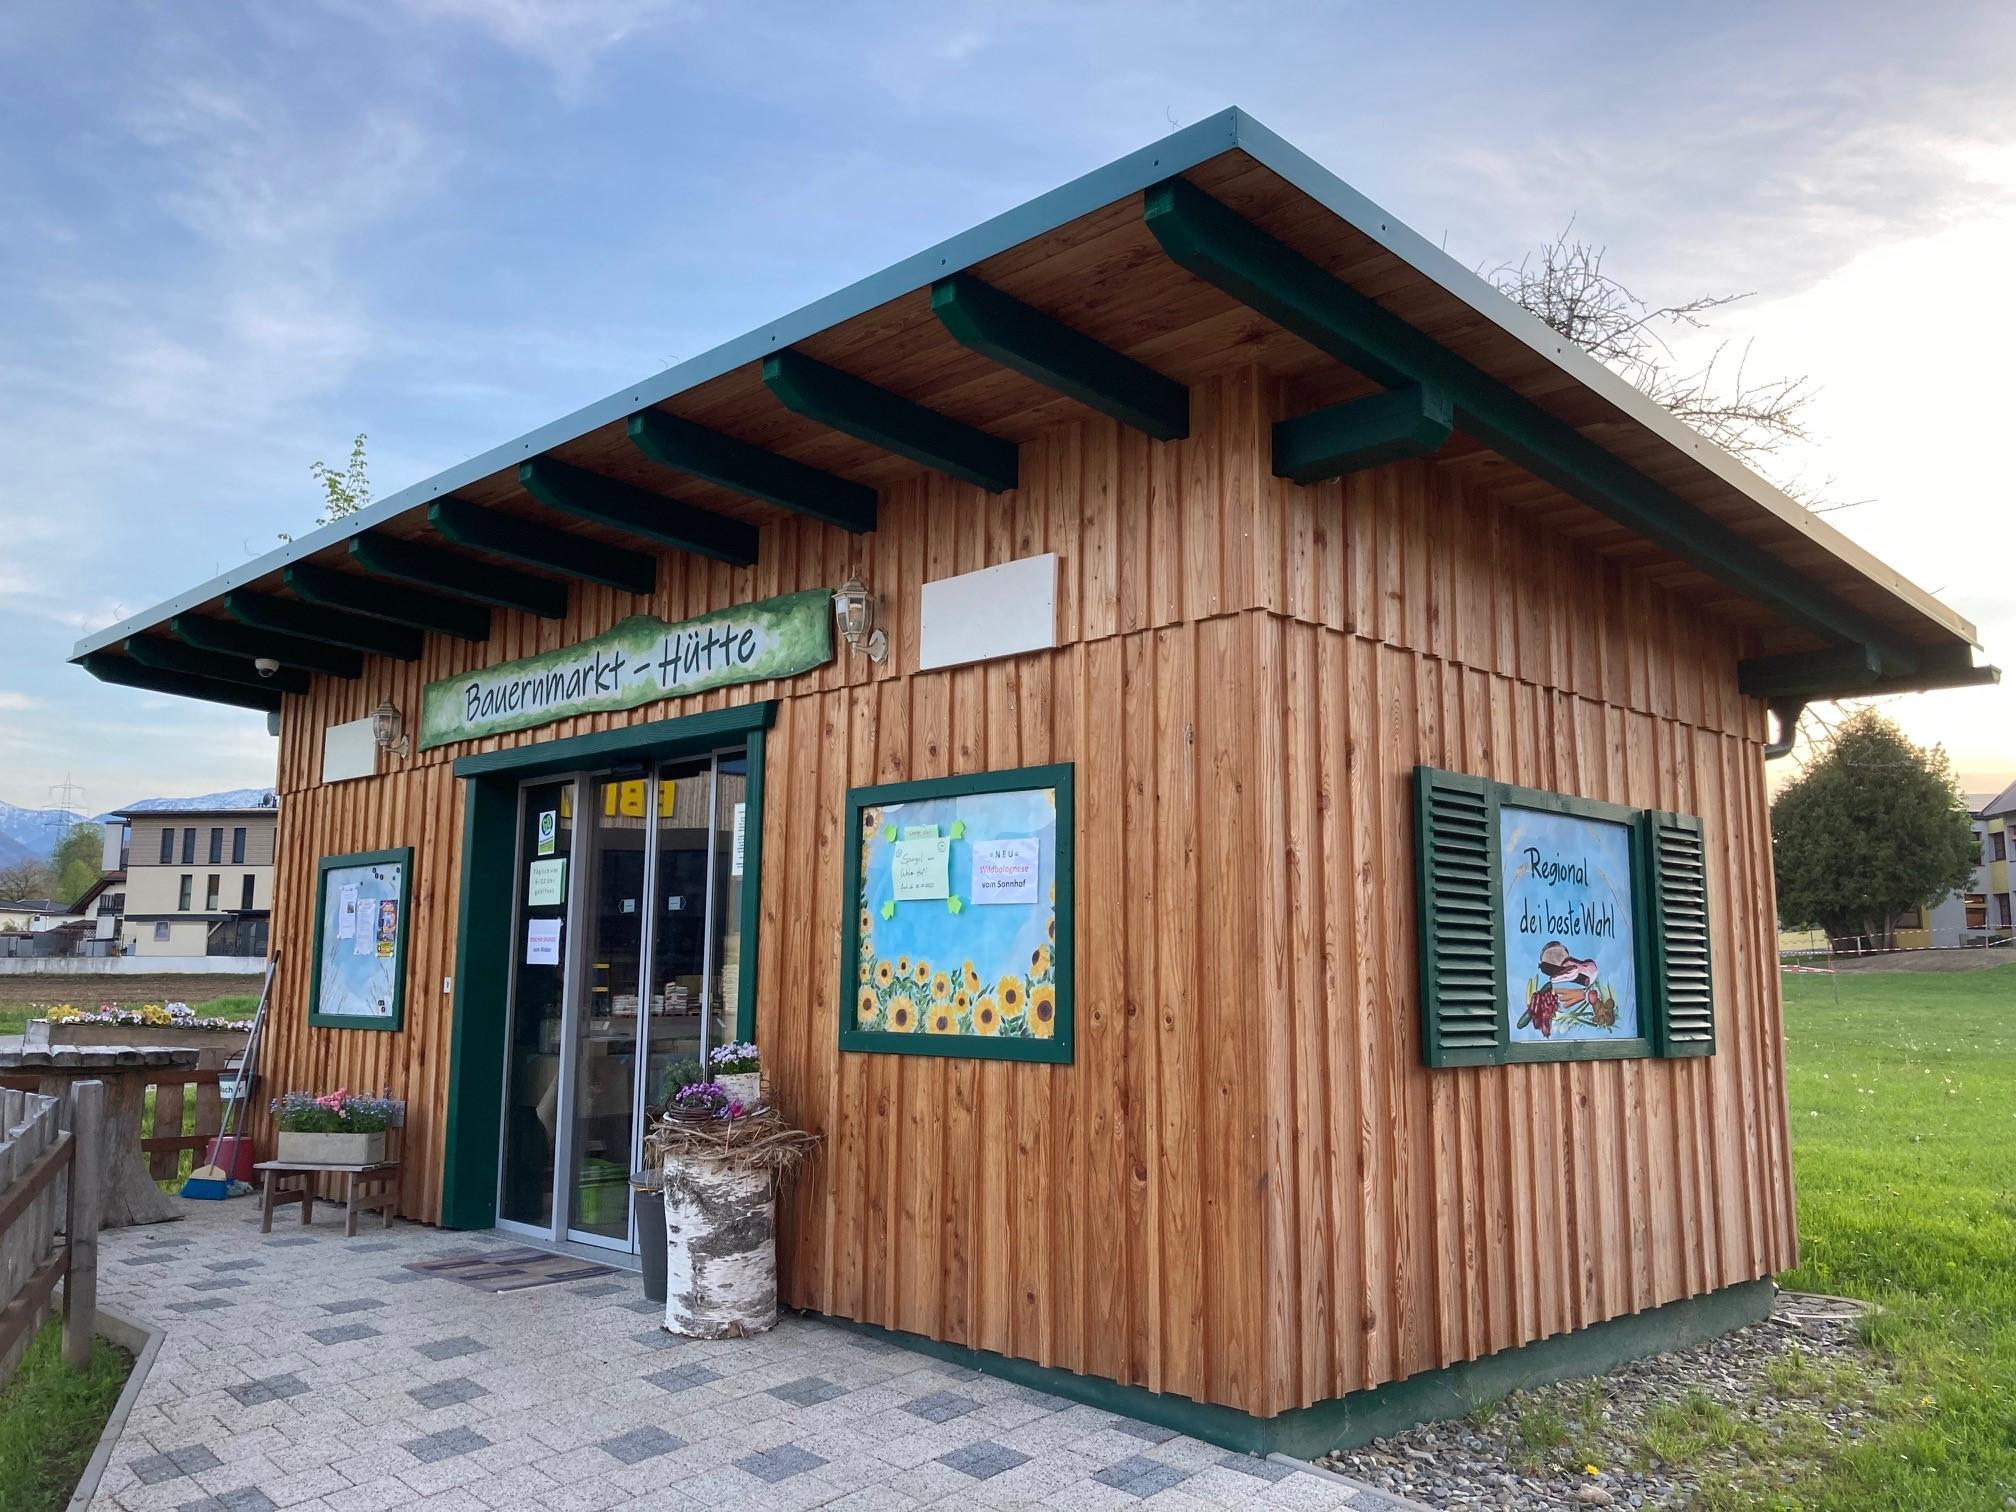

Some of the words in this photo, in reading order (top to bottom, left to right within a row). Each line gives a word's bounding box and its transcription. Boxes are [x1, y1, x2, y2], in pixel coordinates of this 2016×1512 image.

[465, 650, 626, 723] Bauernmarkt
[658, 623, 757, 688] Hütte
[980, 864, 1029, 874] Wildbolognese
[997, 879, 1026, 888] Sonnhof
[1523, 846, 1588, 887] Regional
[1545, 898, 1580, 937] beste
[1581, 902, 1615, 939] Wahl
